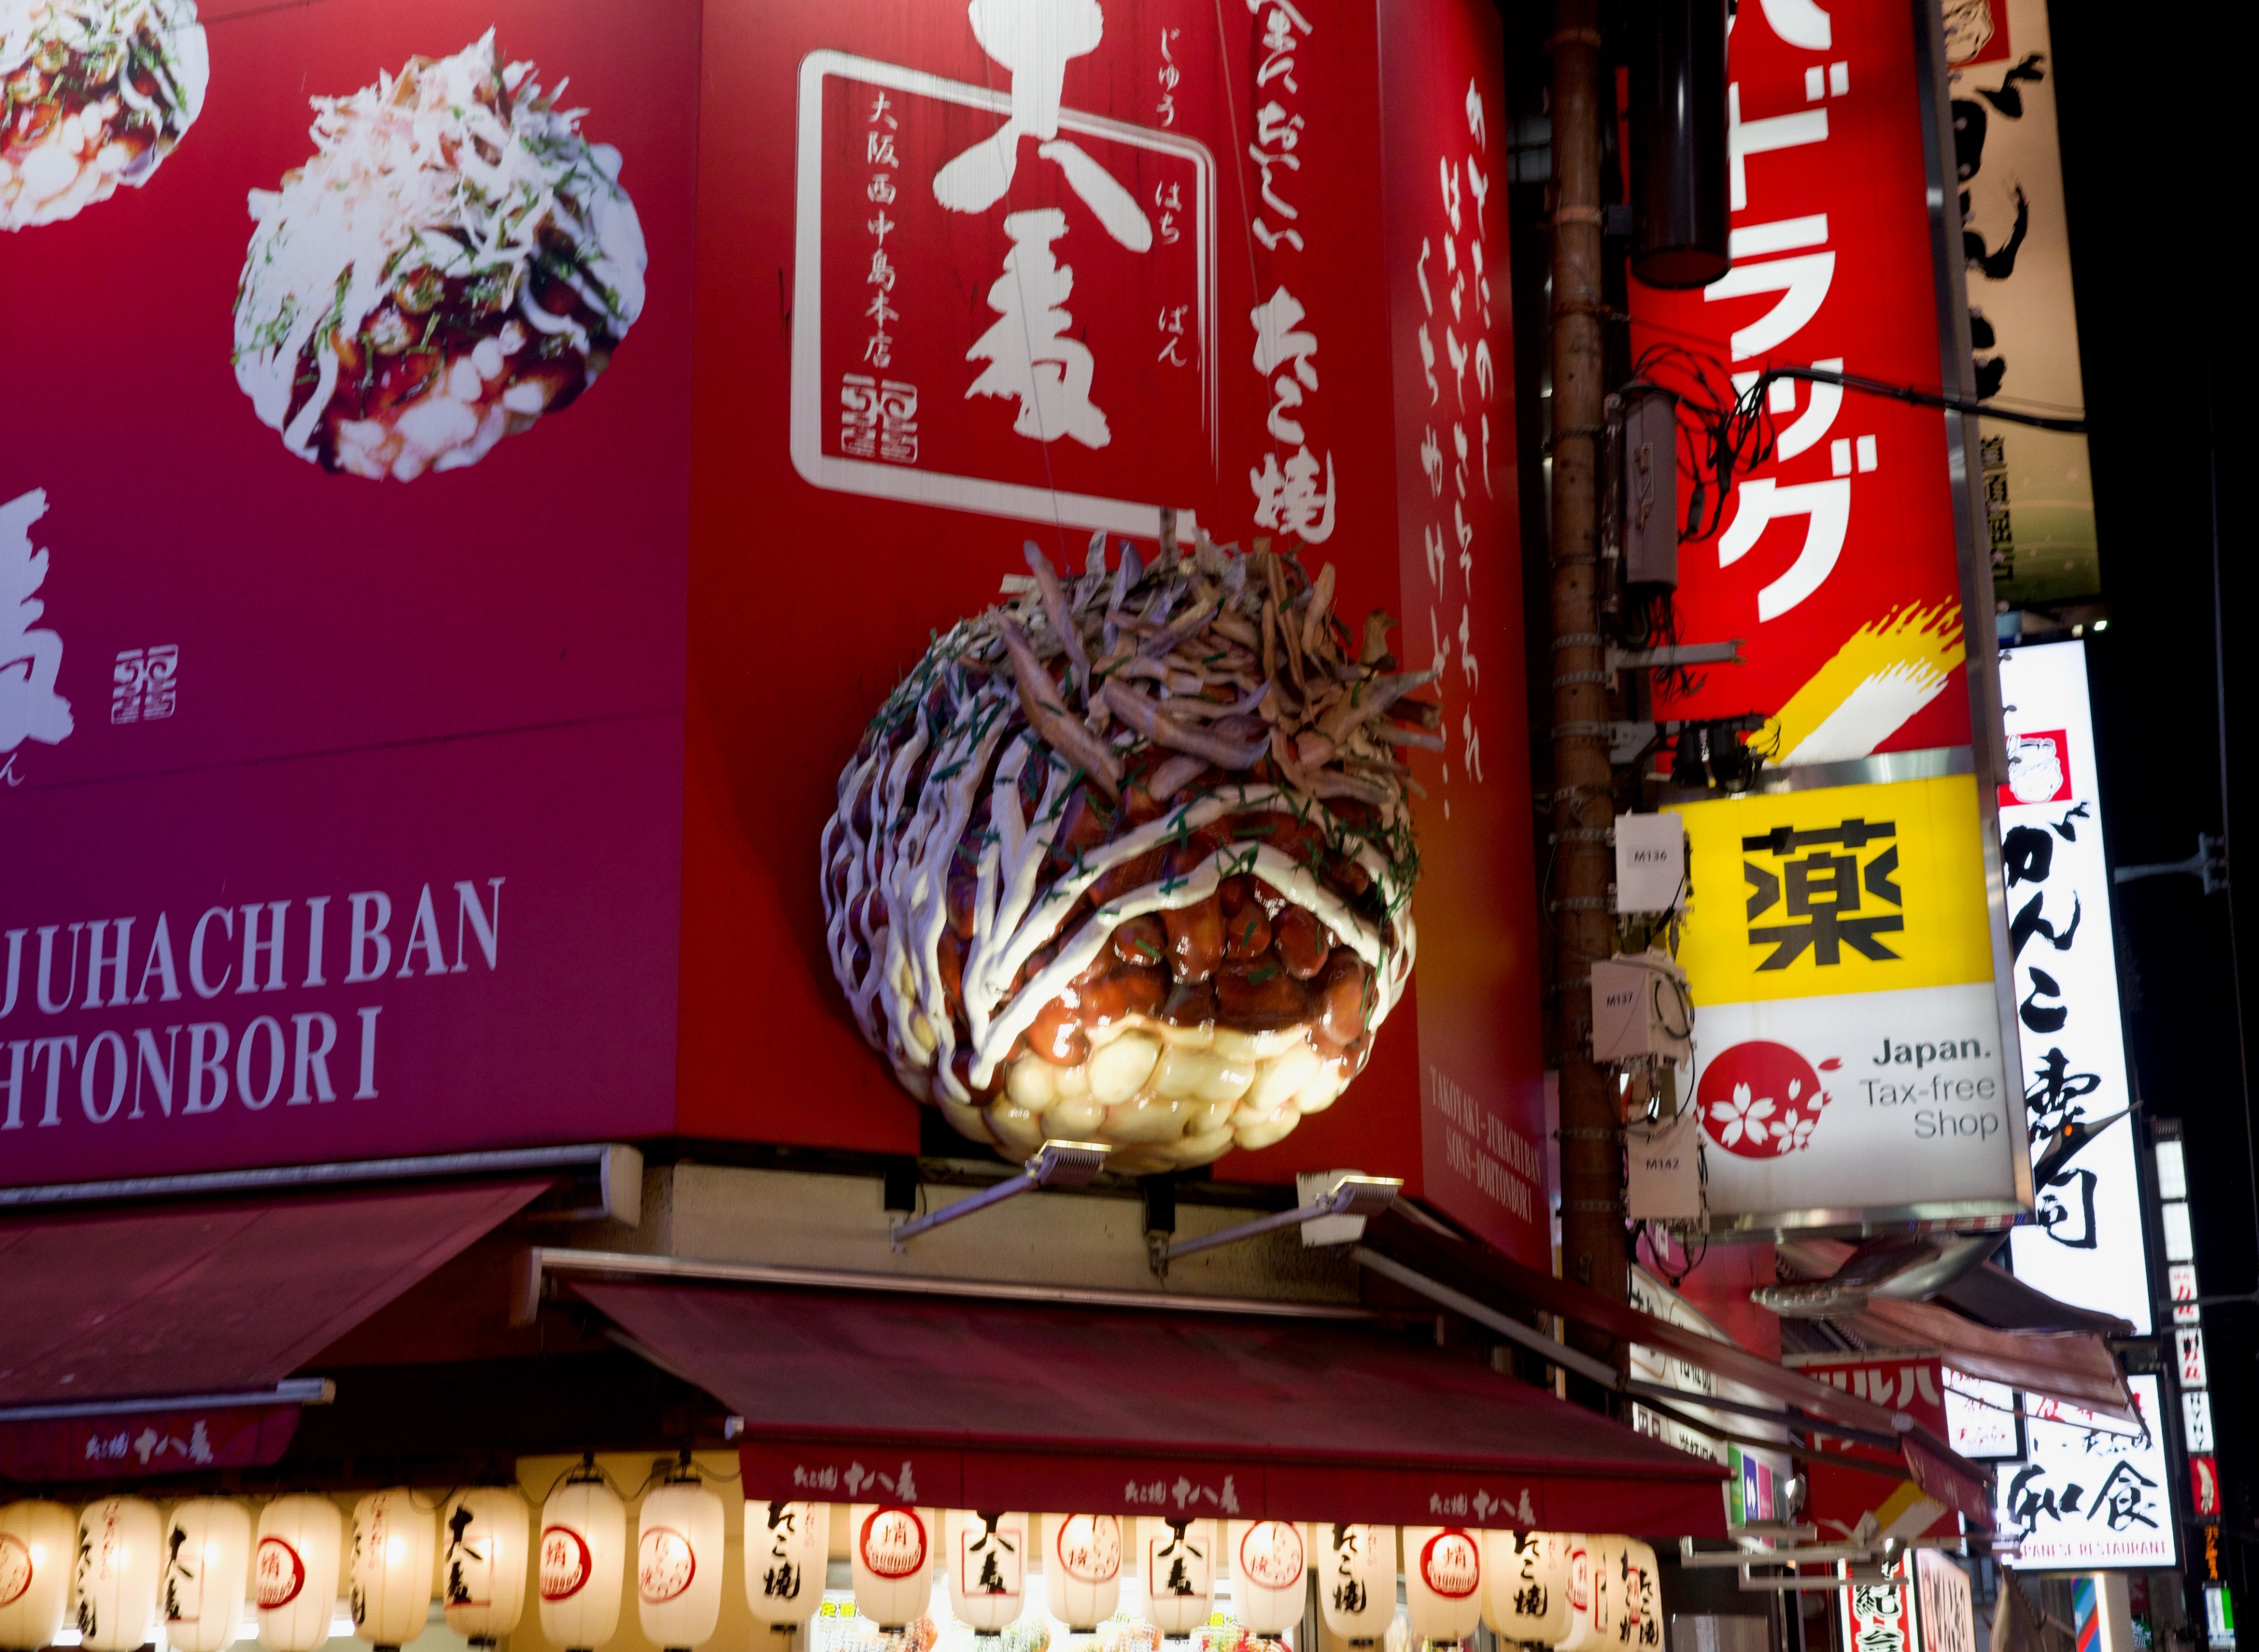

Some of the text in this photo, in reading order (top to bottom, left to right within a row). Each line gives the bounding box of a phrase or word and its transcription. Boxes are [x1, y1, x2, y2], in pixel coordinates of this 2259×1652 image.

[863, 91, 899, 369] 大阪西中島本店
[933, 0, 1153, 449] 十八番
[1155, 27, 1188, 368] じゅう はち ばん
[1704, 0, 1878, 624] ドラッグ
[1250, 285, 1335, 545] たこ焼
[1634, 849, 1667, 863] M136
[1741, 818, 1905, 974] 薬
[1606, 991, 1634, 1007] M137
[1859, 1072, 1996, 1108] Tax-free
[1872, 1037, 1992, 1071] Japan.
[1646, 1158, 1679, 1171] M142
[1914, 1107, 1999, 1140] Shop
